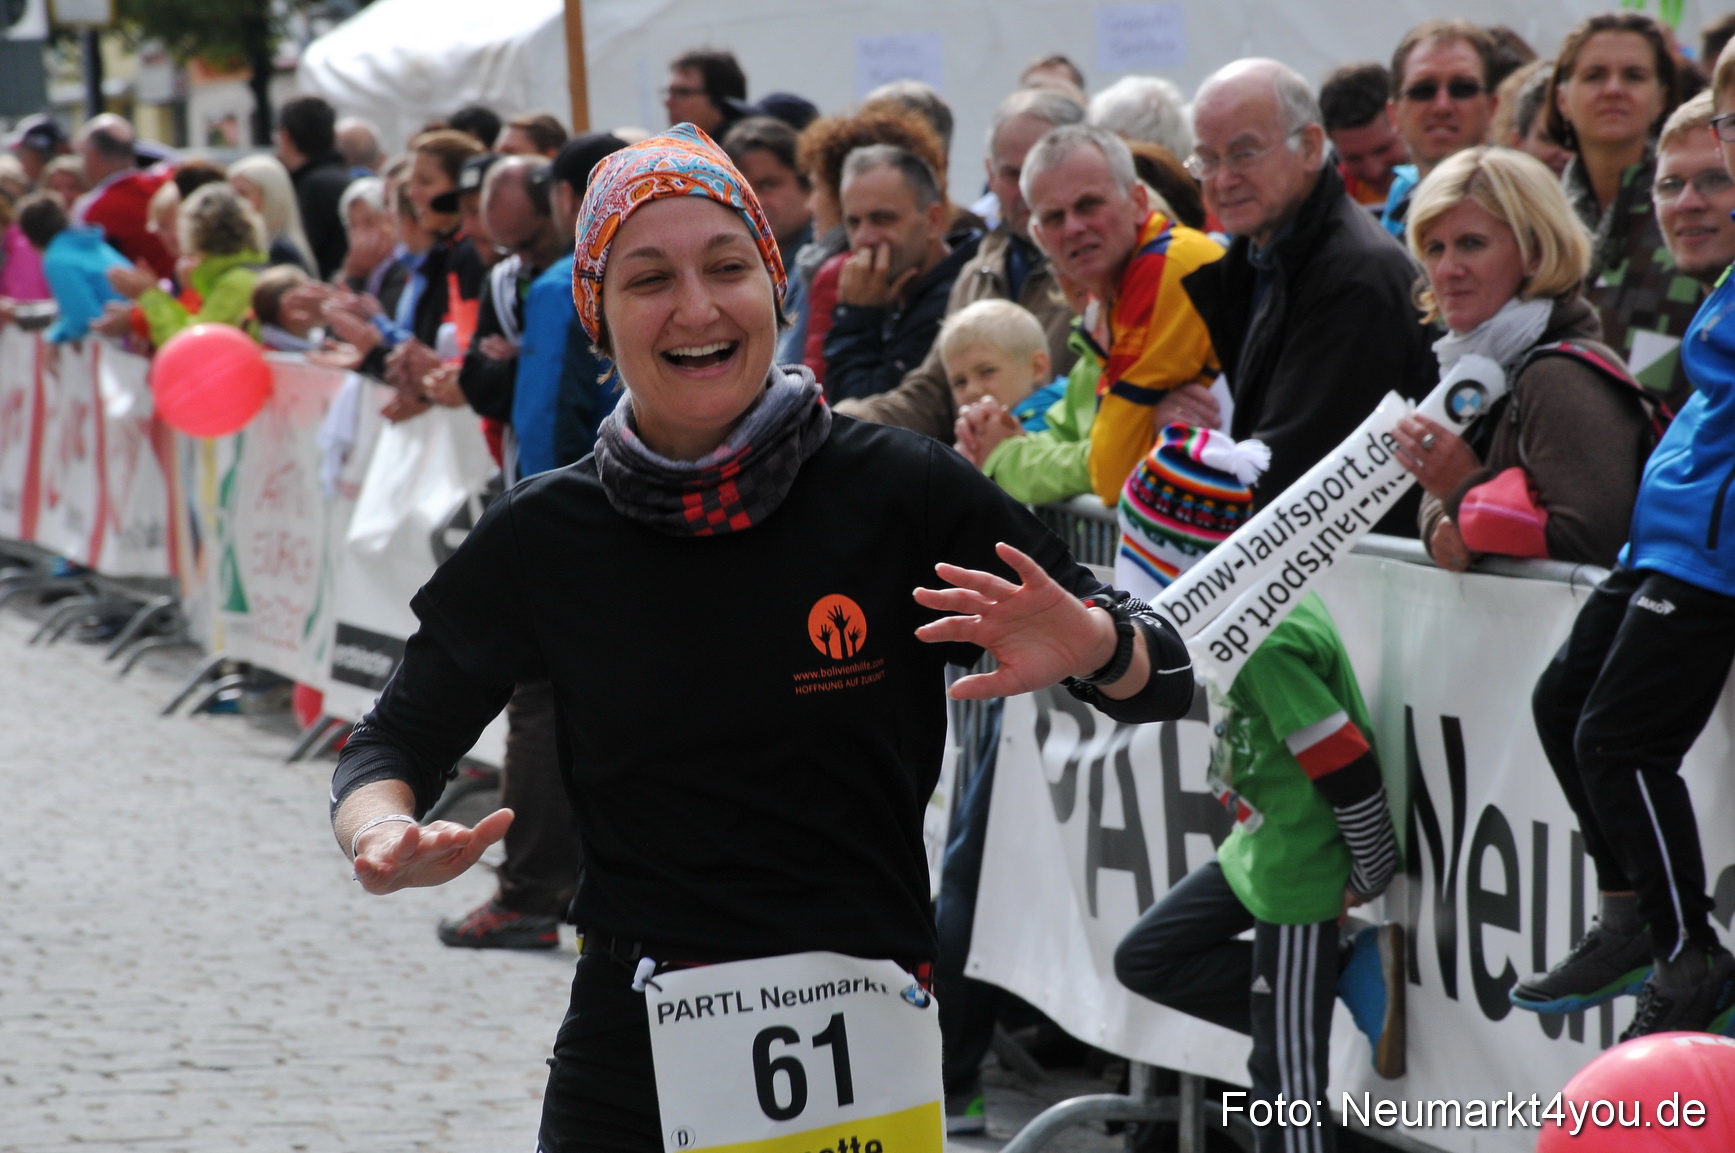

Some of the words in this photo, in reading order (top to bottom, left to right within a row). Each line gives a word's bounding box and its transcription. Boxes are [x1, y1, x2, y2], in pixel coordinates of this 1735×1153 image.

[1161, 429, 1400, 627] bmw-laufsport.de
[1209, 470, 1407, 663] w-laufsport.de
[793, 658, 884, 681] www.bolivienhilfe.com
[795, 681, 844, 695] HOFFNUNG
[845, 677, 859, 688] AUF
[861, 670, 885, 686] ZUKUNFT
[657, 990, 753, 1025] PARTL
[752, 1011, 855, 1121] 61
